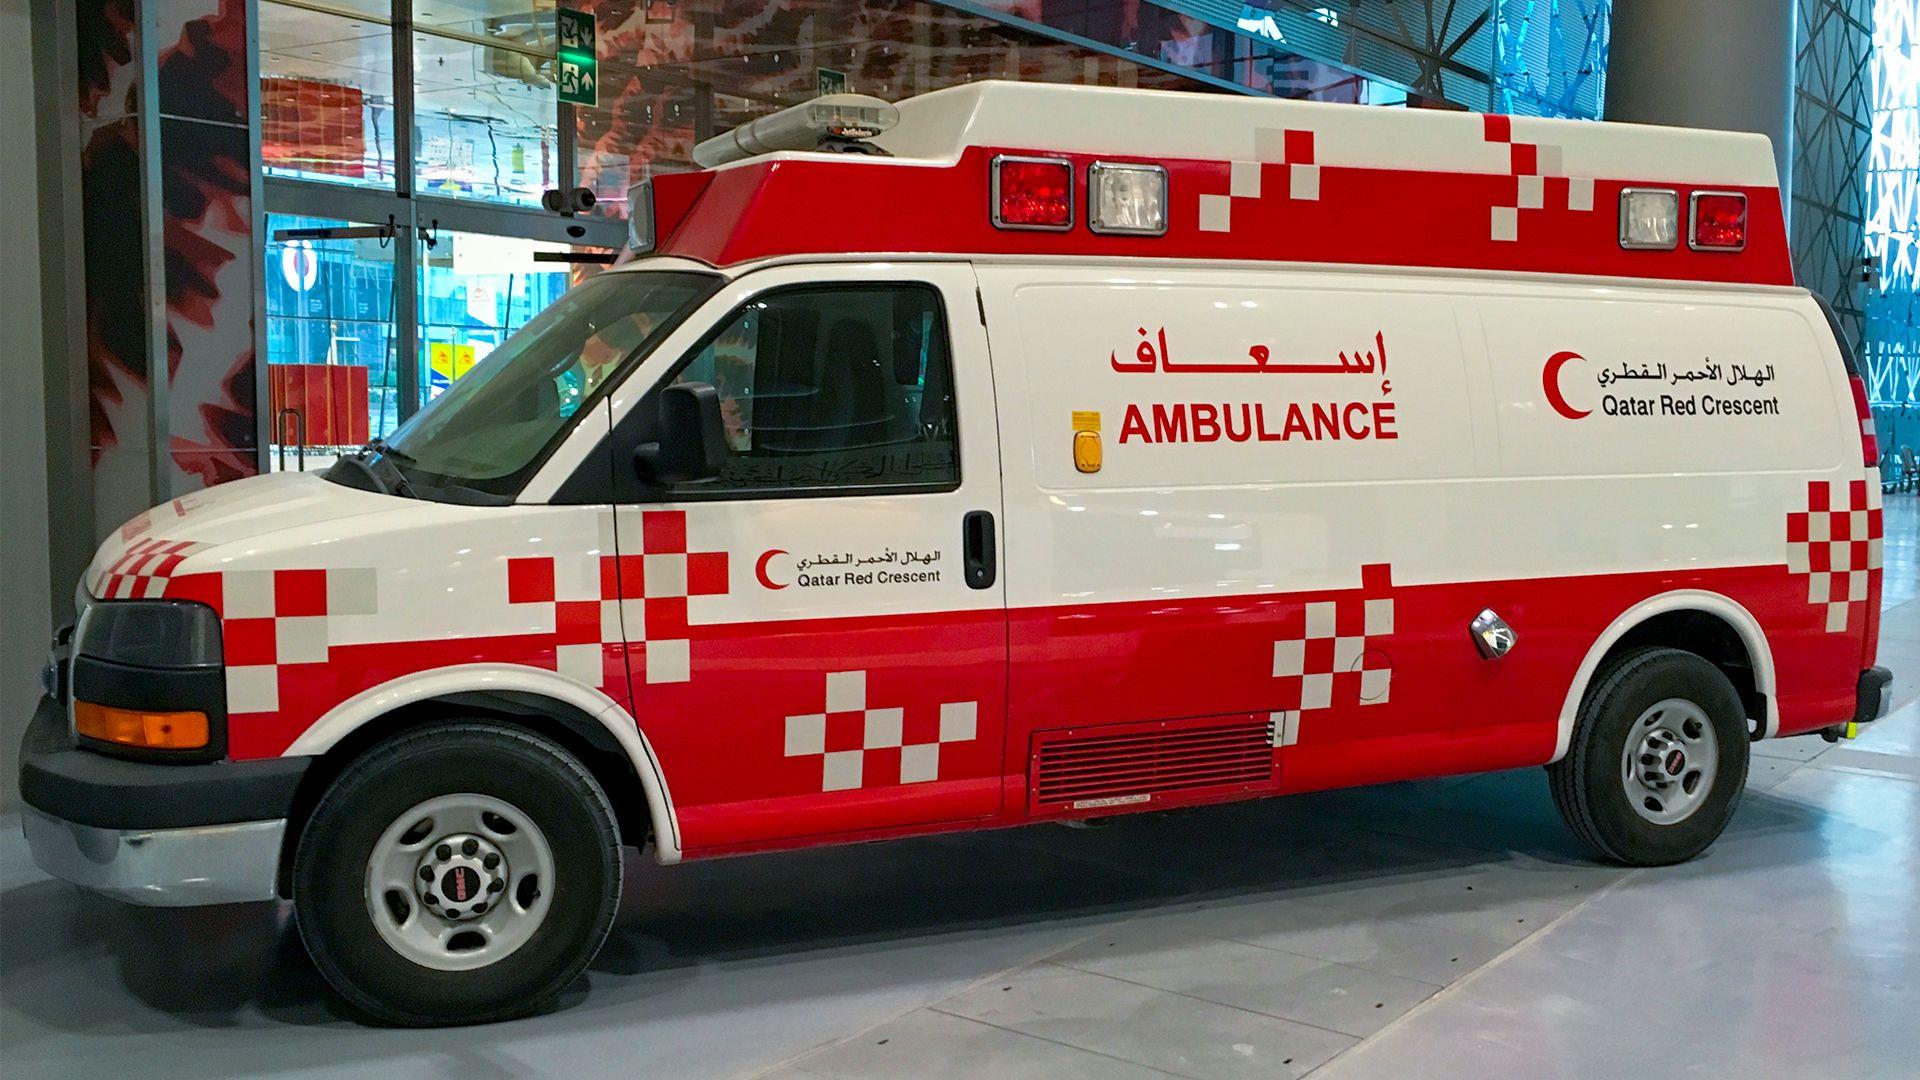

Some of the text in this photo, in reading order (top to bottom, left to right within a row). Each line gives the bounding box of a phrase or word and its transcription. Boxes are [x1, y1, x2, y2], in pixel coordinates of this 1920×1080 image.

[1111, 327, 1392, 395] إسعاف
[1597, 357, 1775, 388] الهلال الأحمر القطري
[1602, 394, 1780, 417] Qatar Red Crescent
[1119, 402, 1399, 444] AMBULANCE
[796, 547, 941, 572] الهلال الأحمر القطري
[797, 570, 941, 588] Qatar Red Crescent
